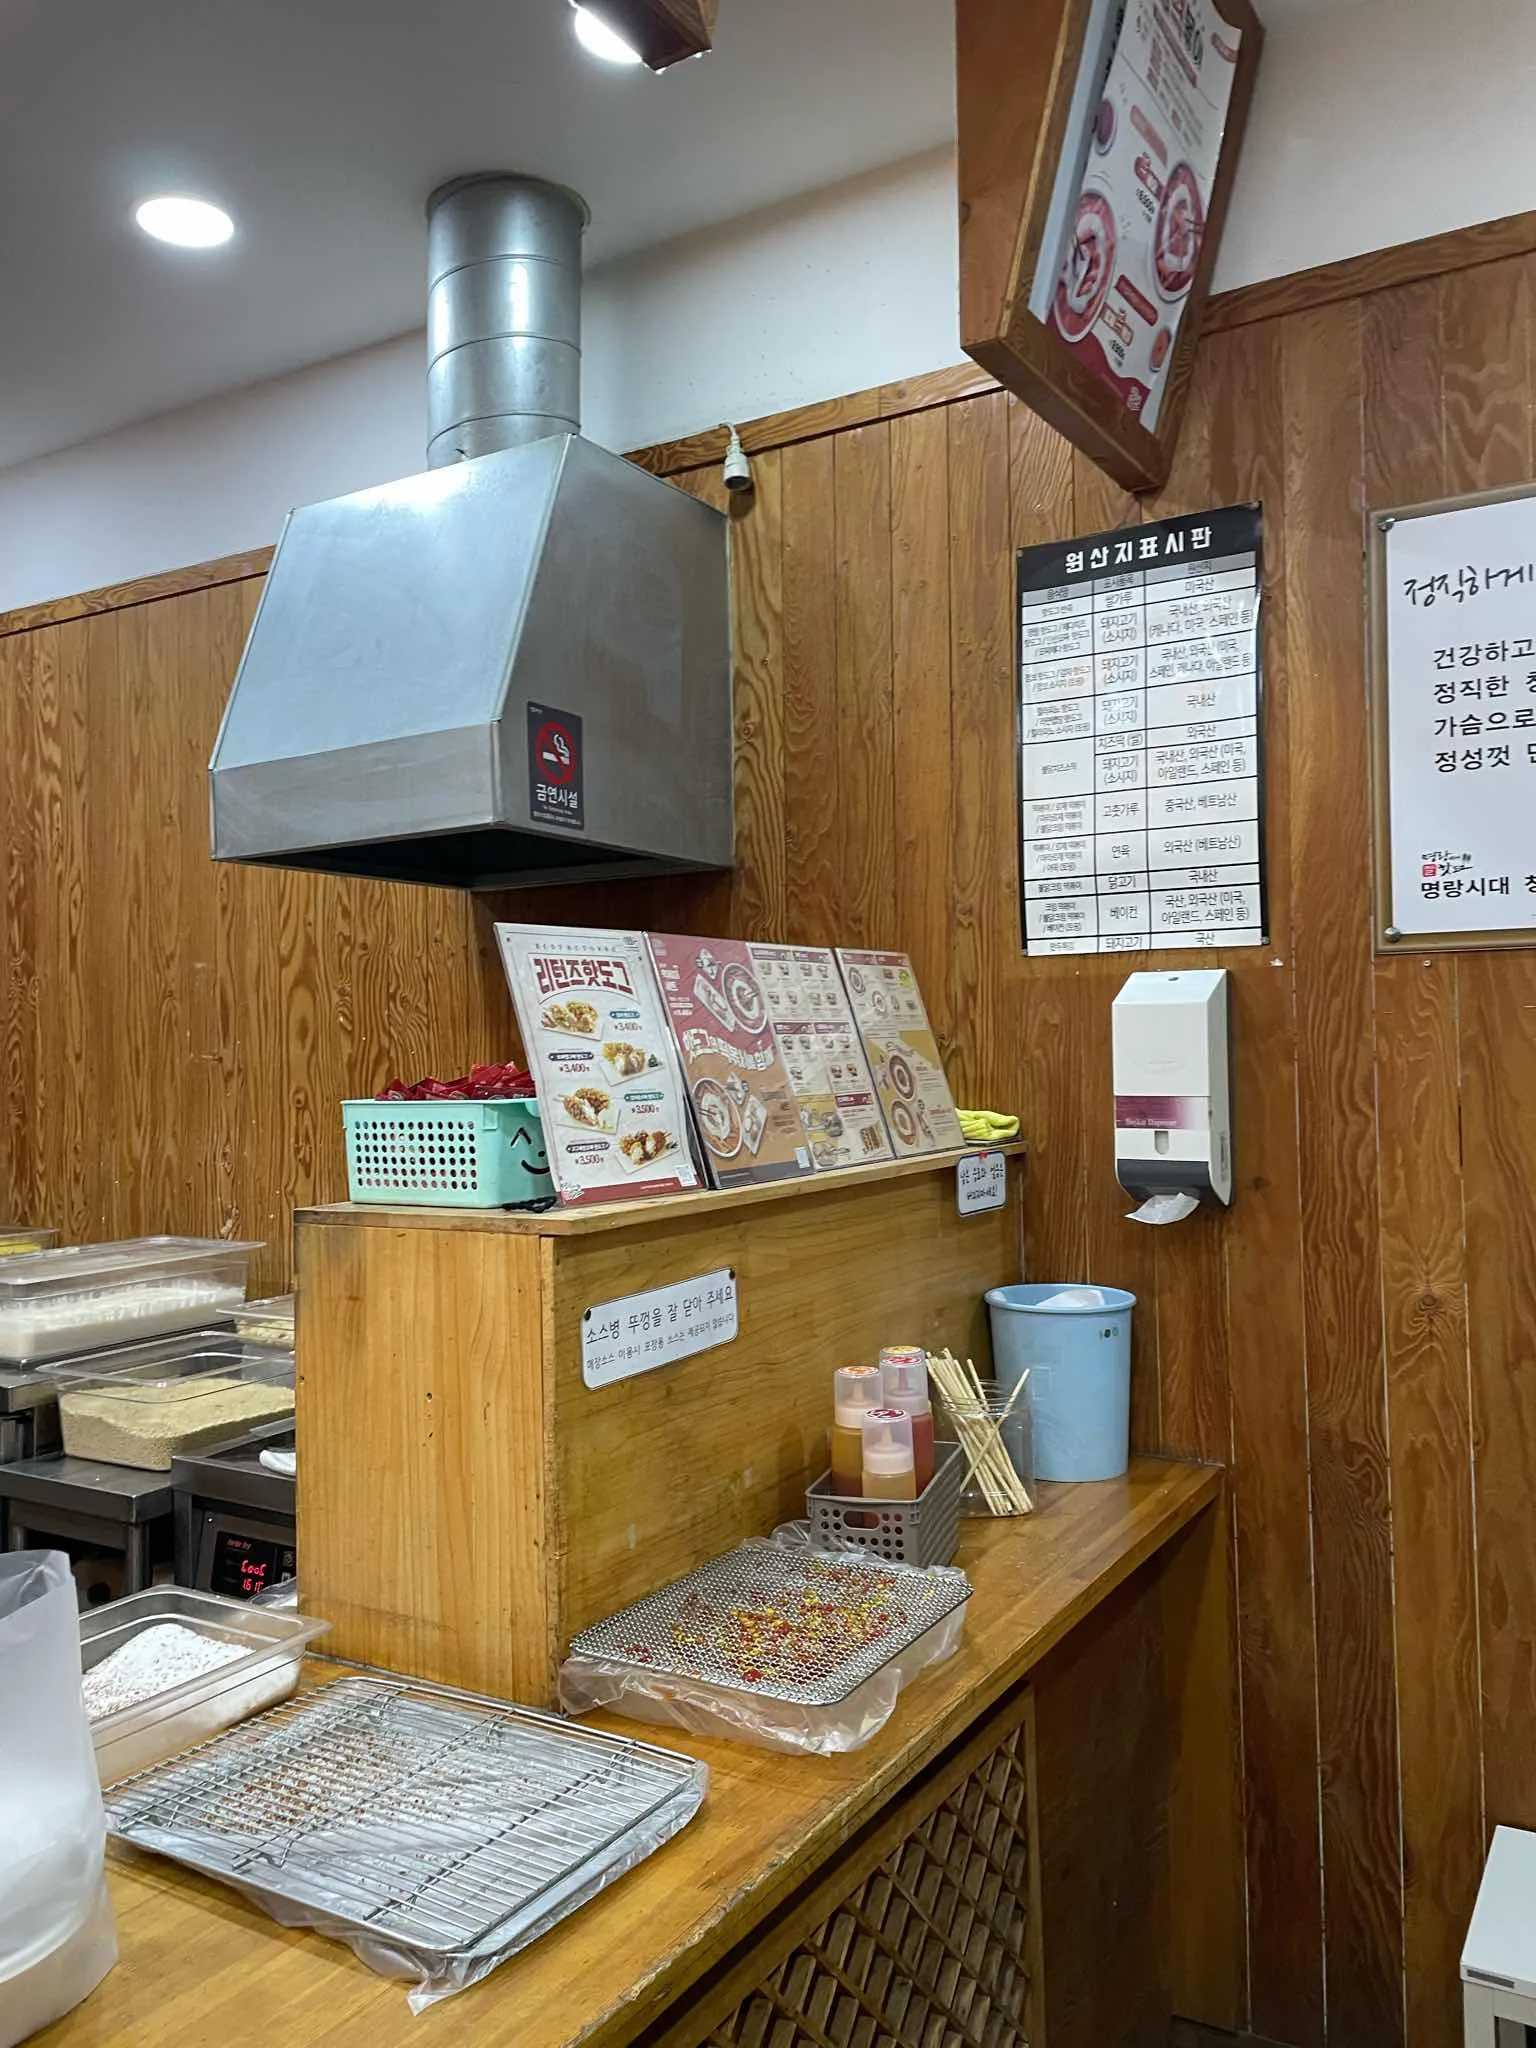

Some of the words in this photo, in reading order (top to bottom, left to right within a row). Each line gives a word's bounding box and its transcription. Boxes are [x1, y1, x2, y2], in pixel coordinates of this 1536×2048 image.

[1065, 526, 1213, 574] 원산지표시판
[1184, 577, 1215, 592] 미국산
[1403, 563, 1535, 607] 정직하게
[1100, 612, 1138, 630] 돼지고기
[1103, 627, 1137, 643] (소시지)
[1433, 638, 1536, 670] 건강하고
[1101, 655, 1139, 672] 돼지고기
[1103, 669, 1137, 685] (소시지)
[1433, 675, 1510, 705] 정직한
[1101, 695, 1138, 712] 돼지고기
[1186, 693, 1216, 708] 국내산
[1103, 709, 1137, 725] (소시지)
[1434, 708, 1536, 738] 가슴으로
[1187, 724, 1217, 739] 외국산
[1098, 735, 1125, 748] 치즈떡
[1155, 748, 1188, 764] 국내산,
[1189, 744, 1218, 760] 외국산
[1220, 741, 1246, 758] (미국,
[1434, 744, 1511, 773] 정성껏
[1102, 754, 1139, 771] 돼지고기
[1201, 760, 1231, 775] 스페인
[1232, 757, 1246, 774] 등)
[1103, 769, 1138, 786] (소시지)
[535, 783, 578, 809] 금연시설
[1164, 797, 1197, 813] 중국산,
[1197, 793, 1238, 808] 베트남산
[1102, 801, 1141, 818] 고춧가루
[1112, 843, 1131, 860] 연육
[1163, 839, 1194, 854] 외국산
[1195, 834, 1242, 852] (베트남산)
[1108, 875, 1137, 890] 닭고기
[1188, 869, 1218, 883] 국내산
[1421, 876, 1510, 900] 명랑시대
[1164, 895, 1188, 909] 국산,
[1188, 892, 1219, 907] 외국산
[1219, 889, 1246, 905] (미국,
[1109, 904, 1138, 920] 베이컨
[1204, 907, 1235, 922] 스페인
[1236, 906, 1251, 922] 등)
[1105, 935, 1143, 951] 돼지고기
[1194, 931, 1216, 946] 국산
[533, 958, 634, 995] 리턴즈핫도그
[586, 1318, 620, 1345] 소스병
[627, 1307, 663, 1335] 뚜껑을
[667, 1303, 679, 1323] 잘
[683, 1295, 702, 1318] 닫아
[706, 1285, 734, 1309] 주세요
